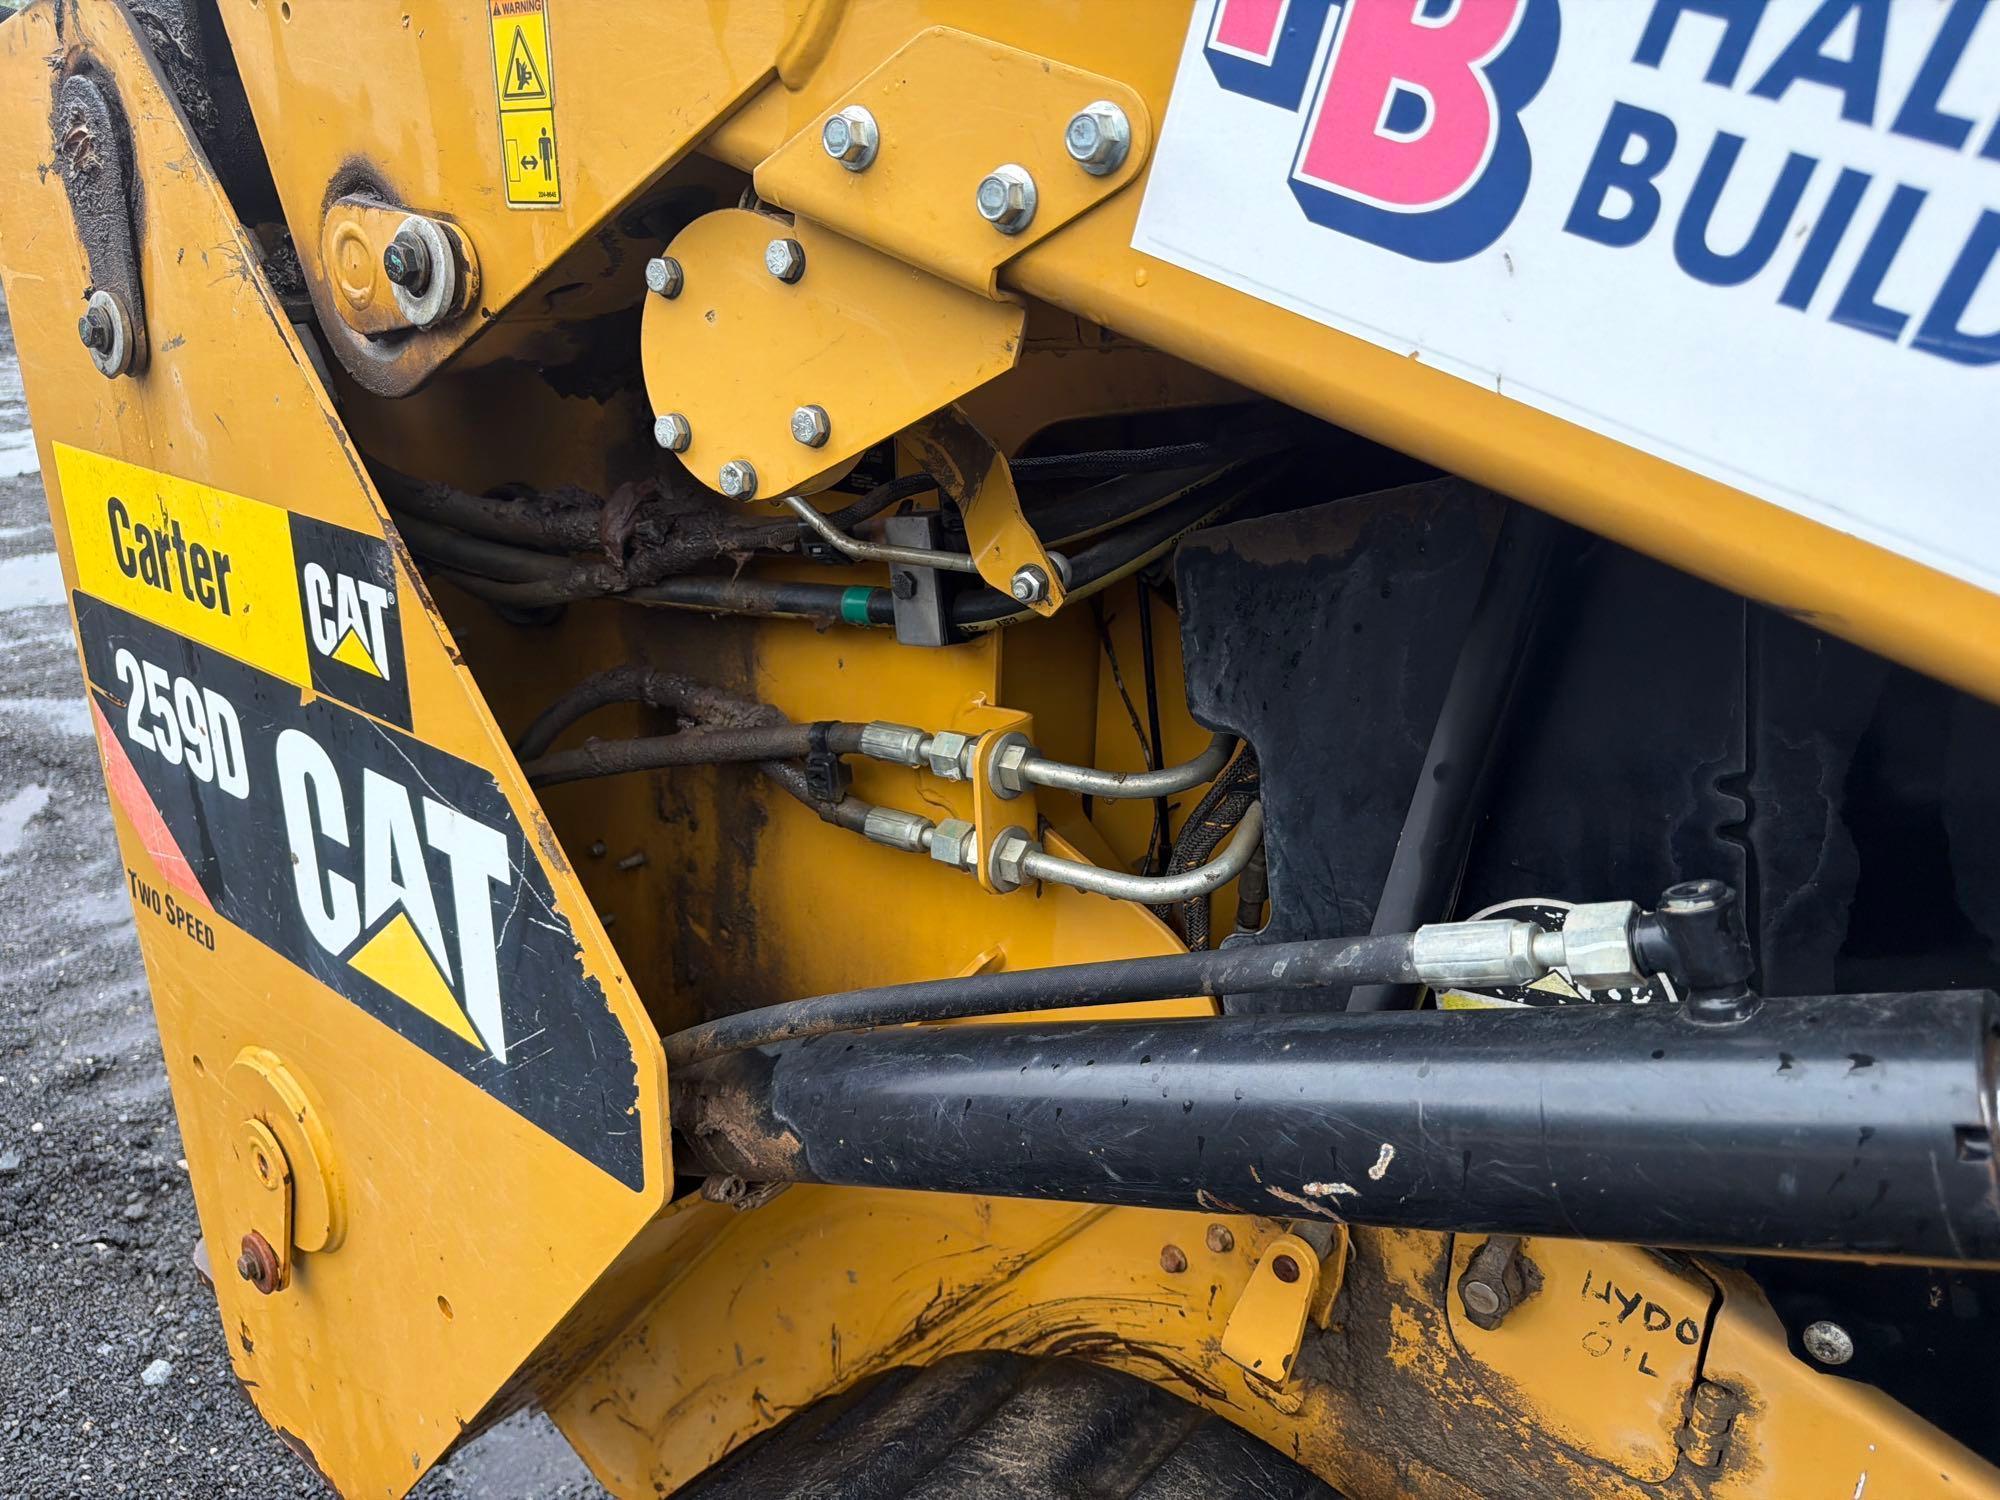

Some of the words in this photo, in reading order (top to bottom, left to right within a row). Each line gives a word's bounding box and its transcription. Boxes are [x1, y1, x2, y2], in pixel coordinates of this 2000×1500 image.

[502, 0, 541, 15] WARNING
[107, 496, 232, 617] Carter
[115, 648, 250, 800] 259D
[276, 729, 511, 1065] CAT
